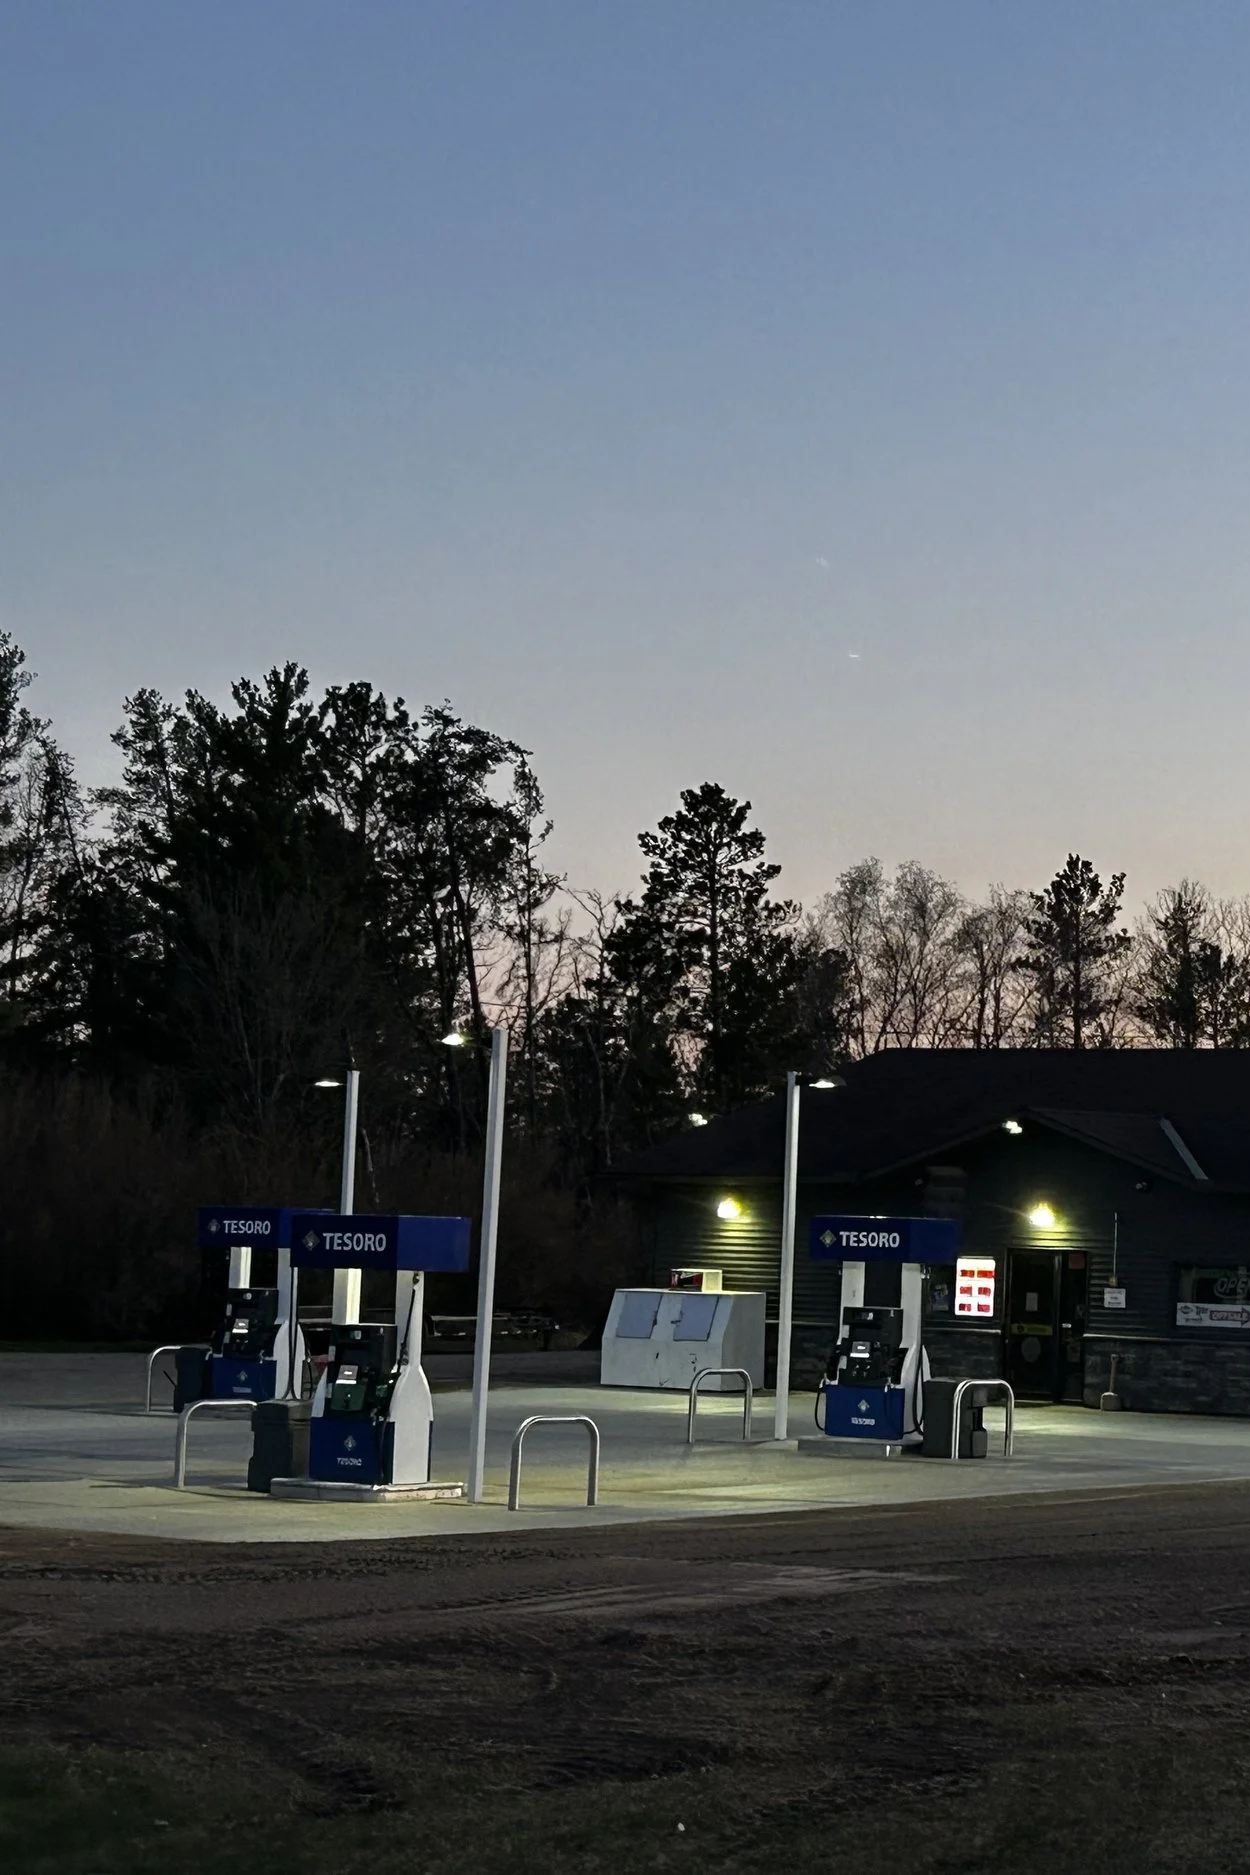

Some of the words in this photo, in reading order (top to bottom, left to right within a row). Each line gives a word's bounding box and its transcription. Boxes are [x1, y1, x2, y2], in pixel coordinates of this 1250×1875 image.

[223, 1220, 271, 1235] TESORO
[322, 1232, 387, 1252] TESORO
[839, 1231, 900, 1248] TESORO
